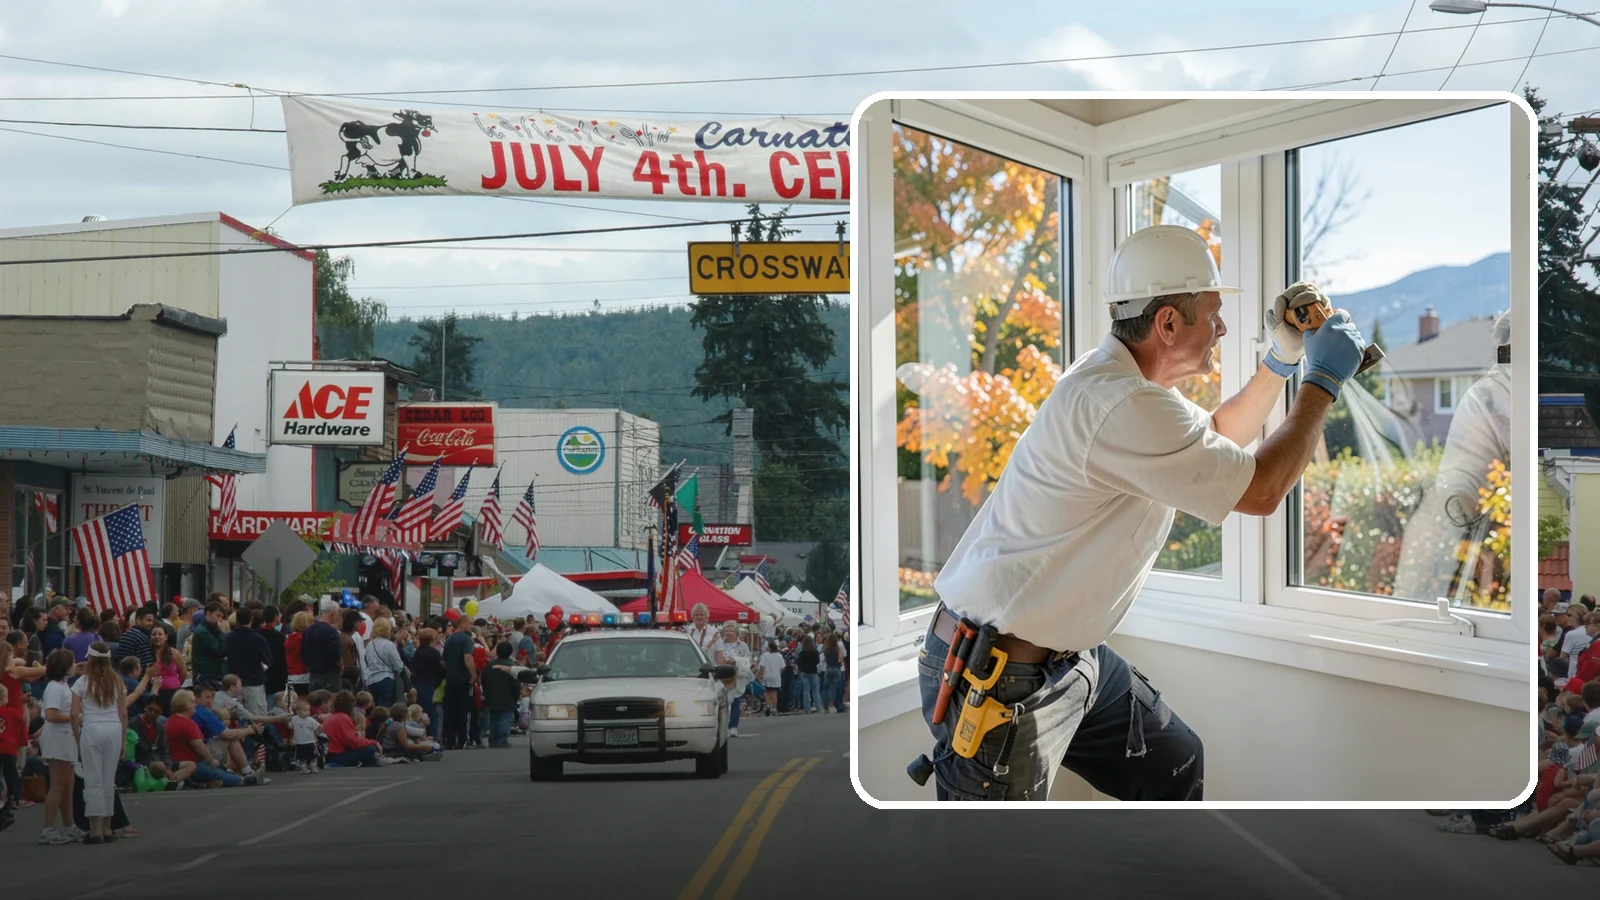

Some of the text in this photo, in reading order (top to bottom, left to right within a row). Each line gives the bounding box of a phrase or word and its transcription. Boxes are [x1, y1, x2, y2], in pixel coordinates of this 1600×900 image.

[481, 141, 605, 192] JULY
[632, 149, 746, 197] 4th.
[696, 254, 850, 280] CROSSWA
[282, 380, 373, 420] ACE
[406, 409, 452, 422] CEDAR
[283, 421, 371, 436] Hardware
[95, 485, 124, 495] Vincent
[126, 485, 136, 495] de
[138, 486, 155, 496] Paul
[688, 526, 741, 535] CRNATION
[699, 535, 730, 543] GLASS
